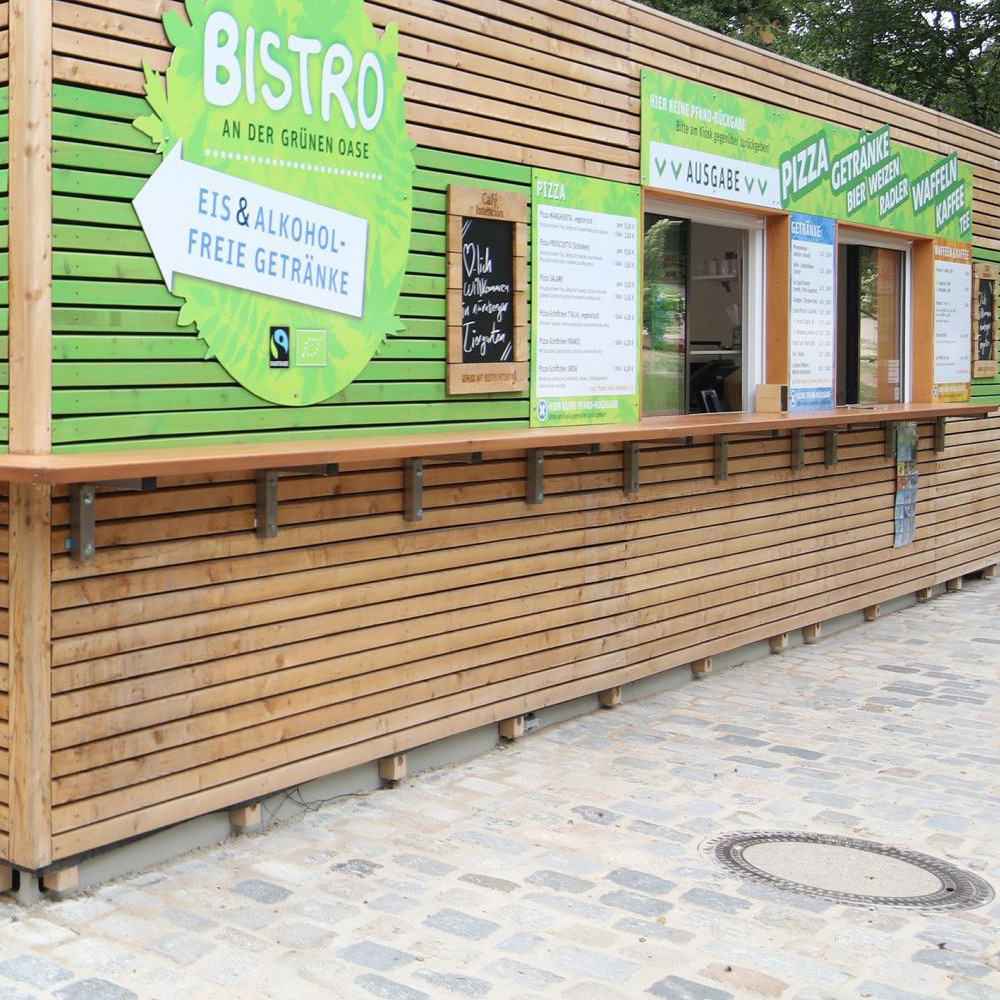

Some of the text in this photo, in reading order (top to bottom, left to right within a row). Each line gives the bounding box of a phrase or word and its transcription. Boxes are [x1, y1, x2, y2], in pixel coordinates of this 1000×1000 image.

[203, 11, 385, 131] BISTRO
[650, 94, 747, 132] HIER KEINE PFAND-RÜCKGABE
[676, 120, 689, 135] Bitte
[690, 126, 698, 136] am
[699, 125, 713, 139] Kiosk
[222, 119, 370, 160] AN DER GRÜNEN OASE
[686, 160, 740, 192] AUSGABE
[781, 138, 829, 201] PIZZA
[831, 130, 890, 190] GETRÄNKE
[868, 156, 900, 195] WEIZEN
[537, 181, 566, 201] PIZZA
[847, 181, 866, 213] BIER
[879, 178, 909, 216] RADLER
[912, 156, 957, 211] WAFFELN
[198, 187, 347, 254] EIS & ALKOHOL-
[936, 184, 965, 228] KAFFEE
[959, 211, 970, 235] TEE
[791, 220, 821, 238] GETRÄNKE
[188, 228, 349, 296] FREIE GETRÄNKE
